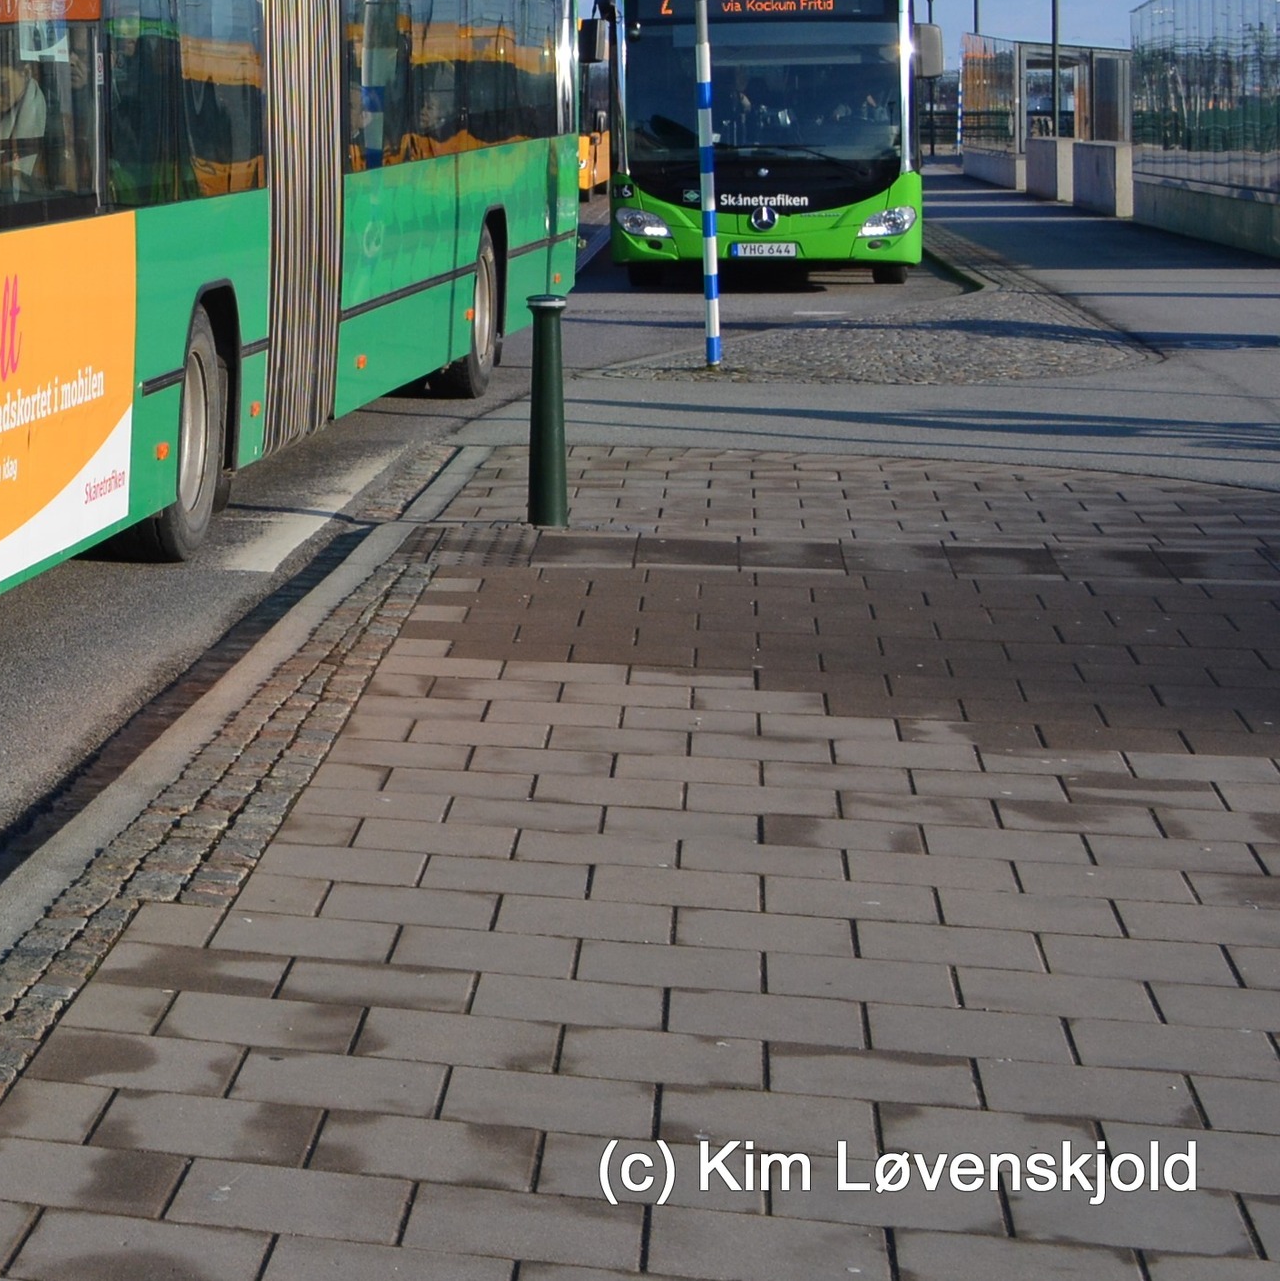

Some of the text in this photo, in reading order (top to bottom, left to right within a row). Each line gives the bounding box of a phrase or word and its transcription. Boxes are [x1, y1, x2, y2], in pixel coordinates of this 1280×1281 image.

[722, 1, 742, 12] via
[746, 0, 797, 12] Kockum
[720, 193, 809, 207] Skånetrafiken
[741, 245, 791, 255] YHG 644
[53, 376, 59, 414] i
[60, 365, 105, 411] mobilen
[2, 457, 18, 485] idag
[84, 468, 126, 505] Skånetrafiken
